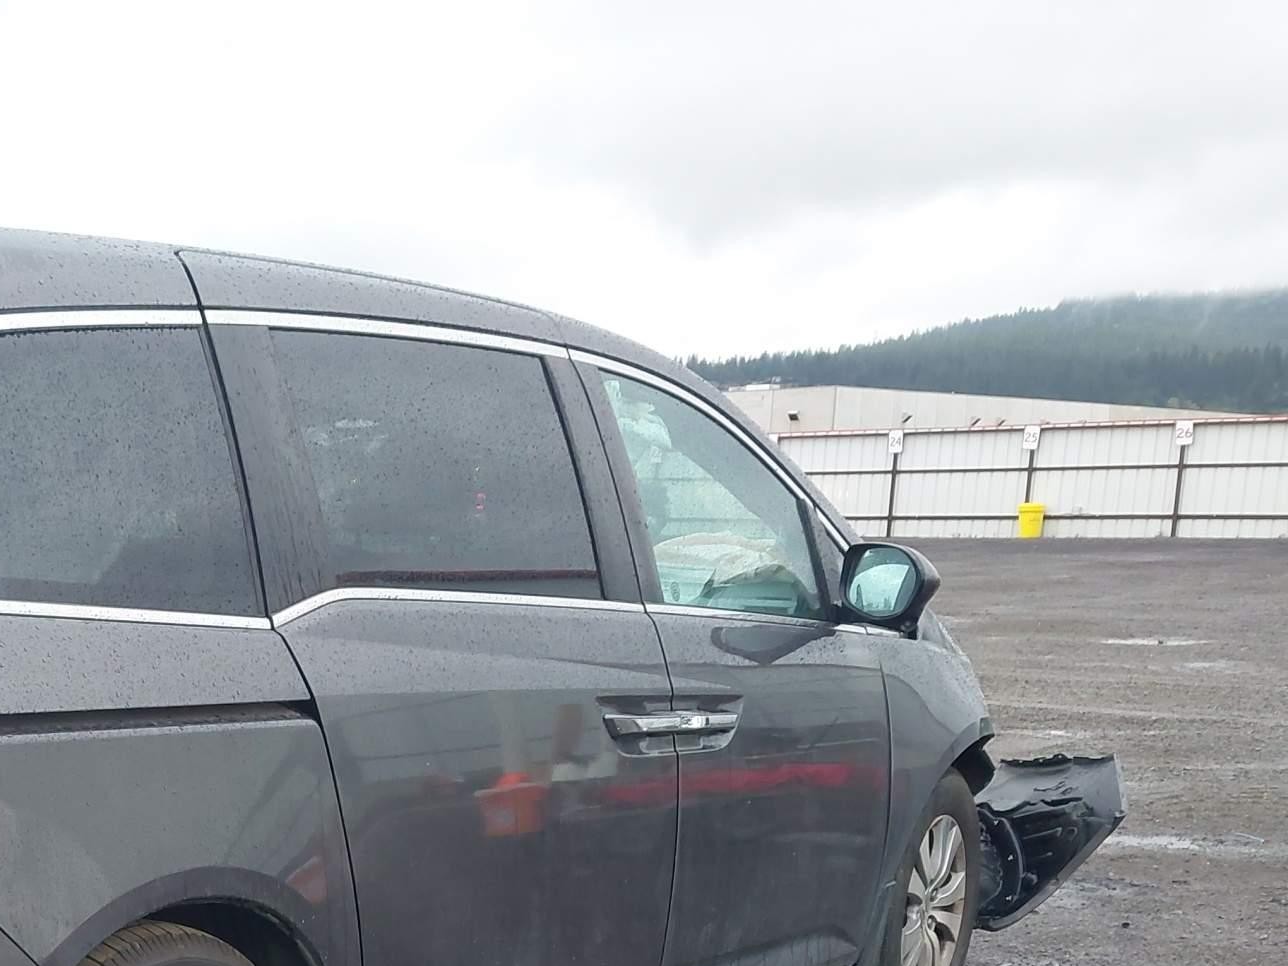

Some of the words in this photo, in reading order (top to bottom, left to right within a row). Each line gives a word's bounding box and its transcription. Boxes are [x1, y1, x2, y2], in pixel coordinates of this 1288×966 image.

[1024, 431, 1038, 442] 25
[1176, 427, 1192, 438] 26
[890, 436, 902, 448] 24
